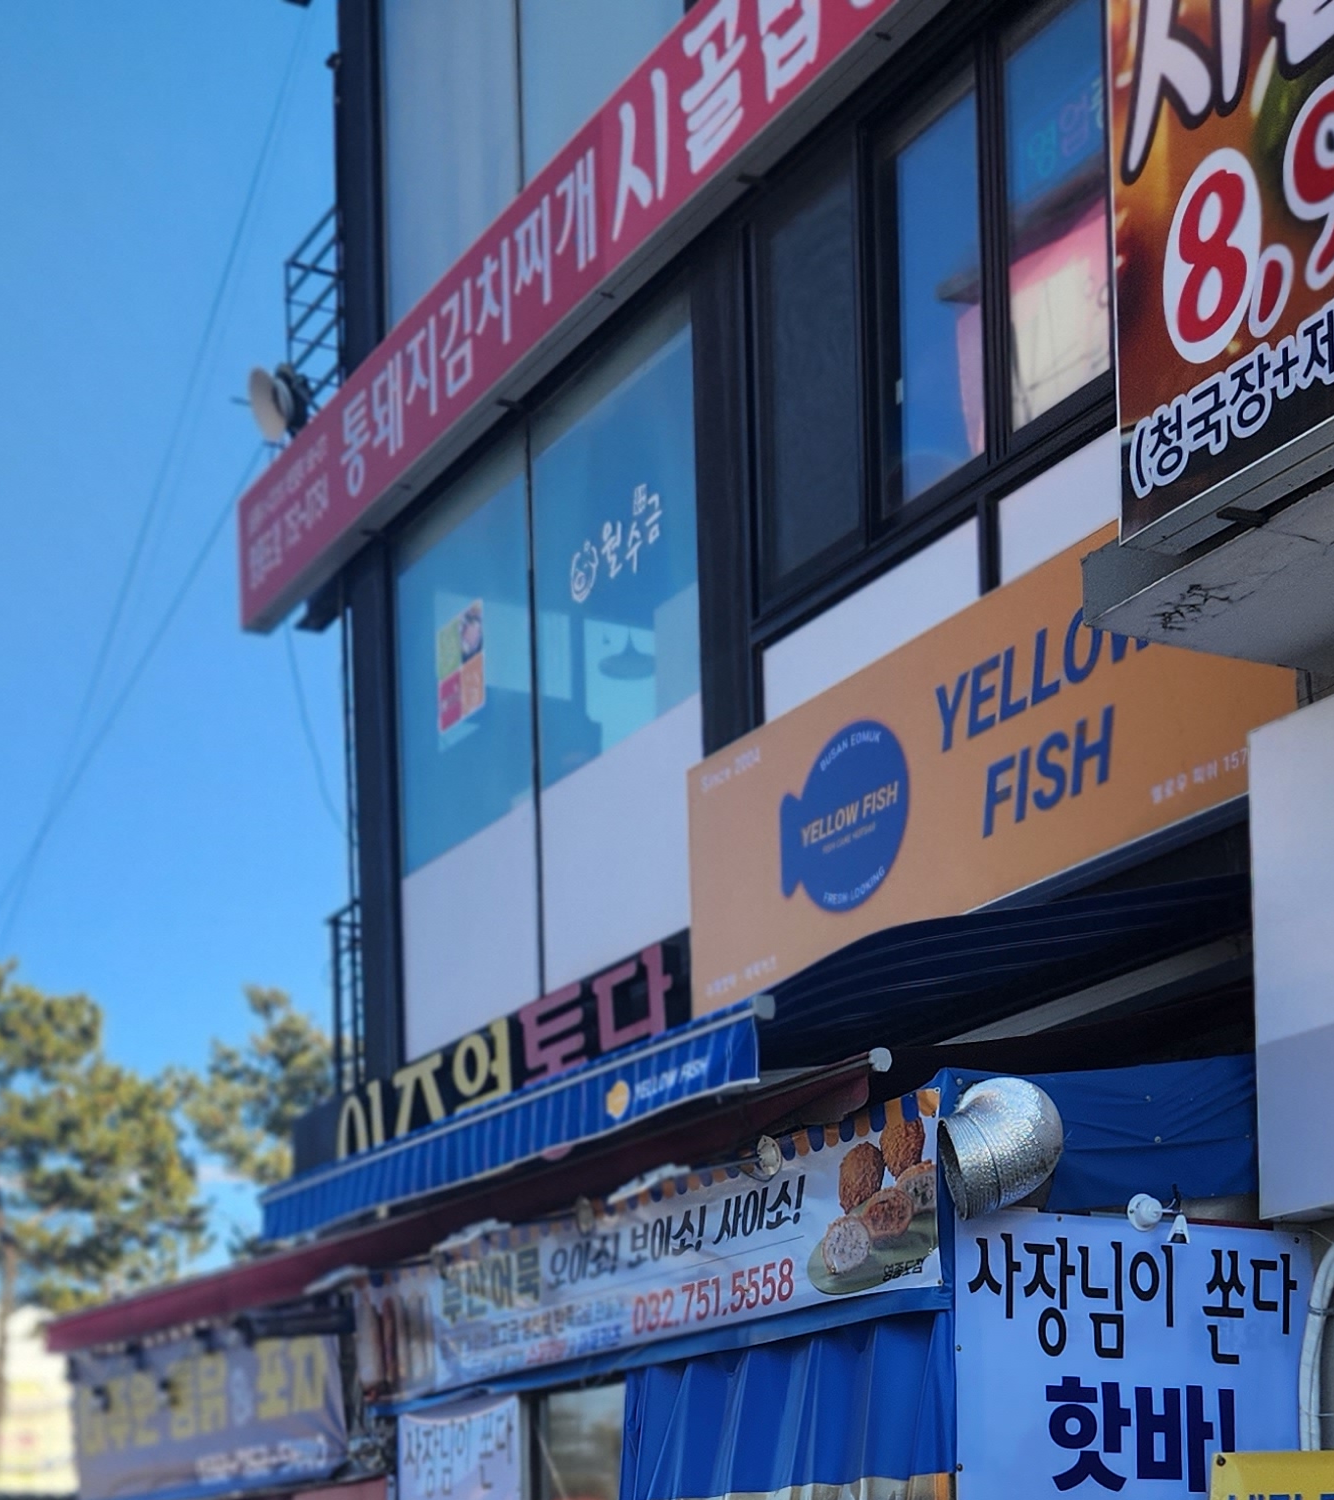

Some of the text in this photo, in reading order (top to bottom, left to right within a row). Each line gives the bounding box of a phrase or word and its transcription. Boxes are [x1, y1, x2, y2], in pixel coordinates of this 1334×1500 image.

[339, 0, 870, 498] 통돼지김치찌개 시골밥
[820, 729, 882, 772] BUSAN EOMUK
[981, 704, 1115, 839] FISH
[800, 780, 900, 848] YELLOW FISH
[627, 1205, 707, 1270] 보이소!
[712, 1174, 806, 1246] 사이소!
[631, 1257, 795, 1336] 032.751.5558
[967, 1232, 1299, 1365] 사장님이 쏜다
